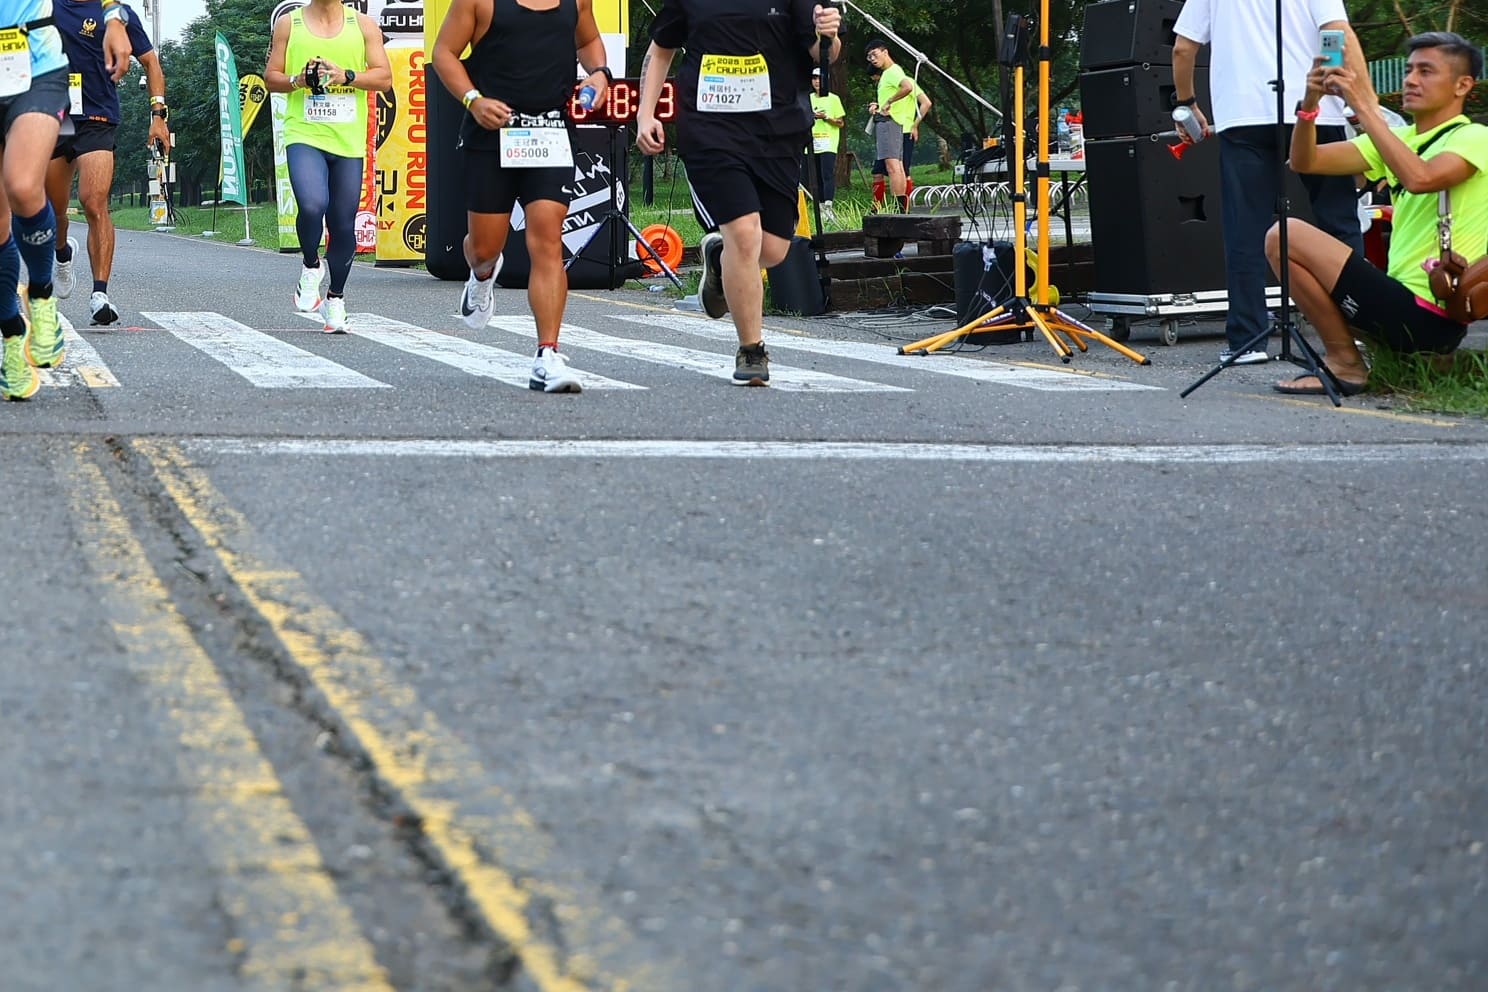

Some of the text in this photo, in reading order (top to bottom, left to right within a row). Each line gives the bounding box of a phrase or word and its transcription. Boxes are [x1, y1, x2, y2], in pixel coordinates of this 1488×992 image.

[717, 57, 740, 65] 2025
[702, 94, 741, 104] 071027
[405, 51, 426, 209] CRUFU RUN
[506, 148, 549, 158] 055008
